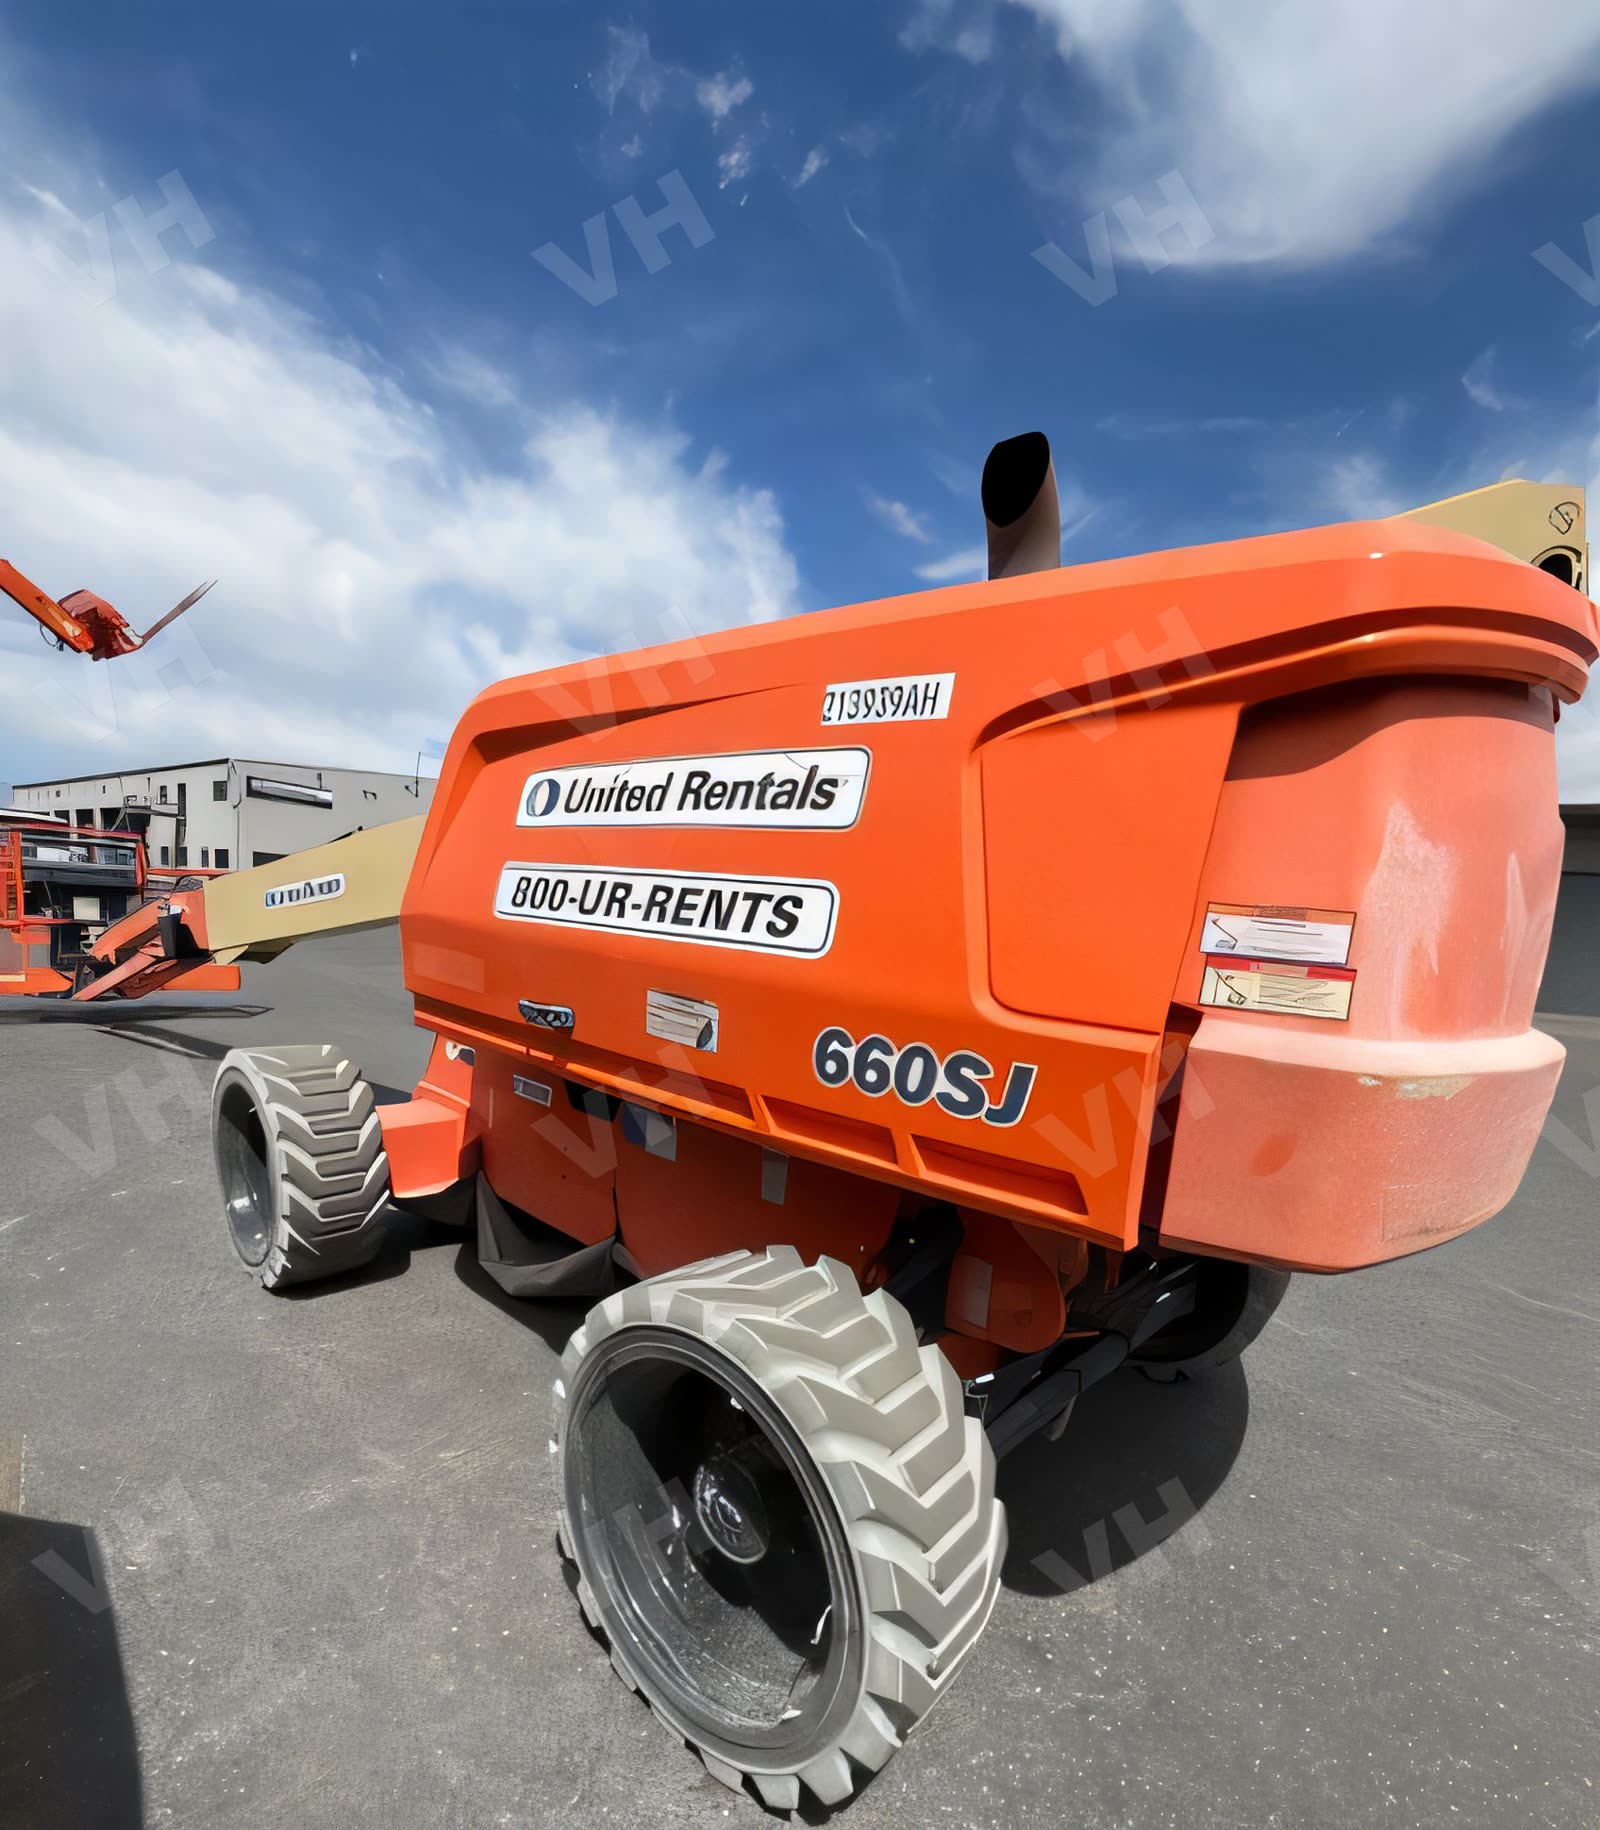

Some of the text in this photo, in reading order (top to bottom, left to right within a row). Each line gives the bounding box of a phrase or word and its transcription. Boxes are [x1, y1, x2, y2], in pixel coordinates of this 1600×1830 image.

[564, 765, 838, 813] United Rentals
[512, 876, 804, 939] 800-UR-RENTS
[813, 1026, 1038, 1127] 660SJ
